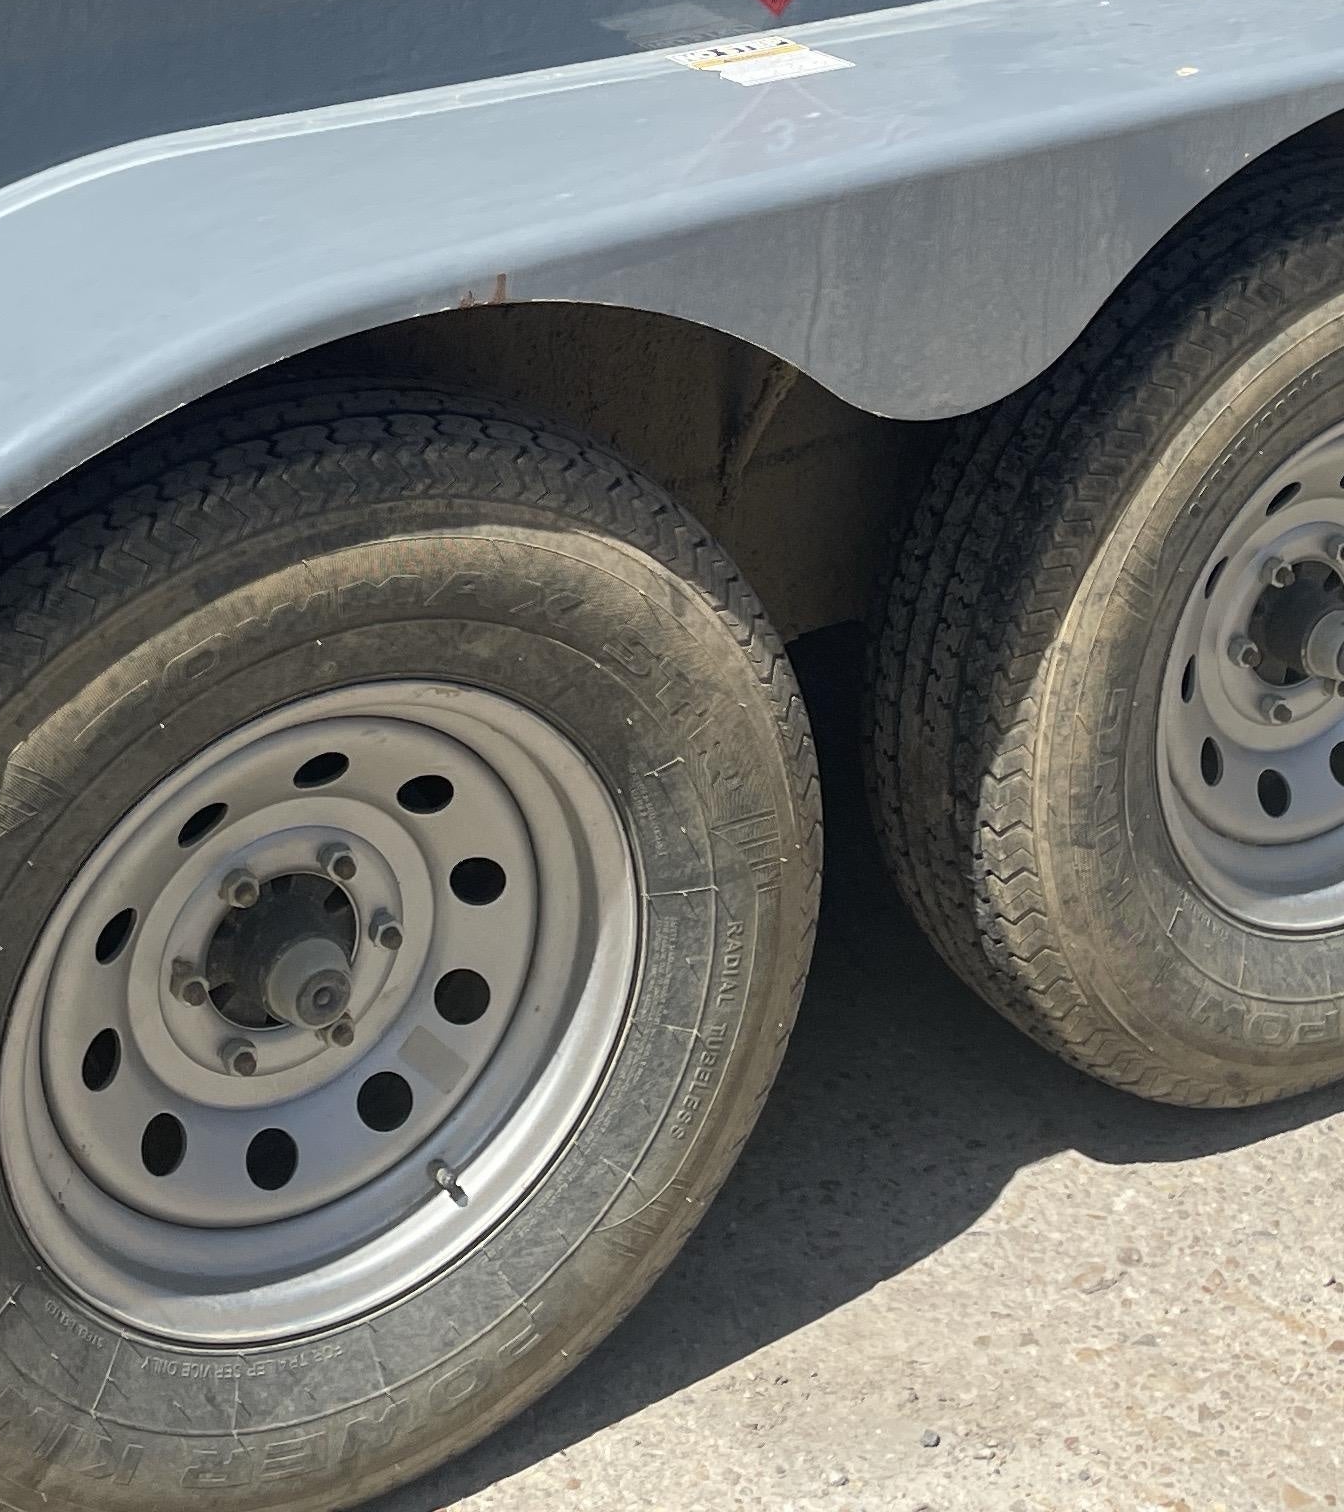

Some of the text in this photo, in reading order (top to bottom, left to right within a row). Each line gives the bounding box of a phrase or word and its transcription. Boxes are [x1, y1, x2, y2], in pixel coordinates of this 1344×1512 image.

[665, 916, 745, 1141] RADIAL TUBELESS
[140, 1354, 179, 1377] ONLY
[178, 1362, 242, 1379] SERVICE
